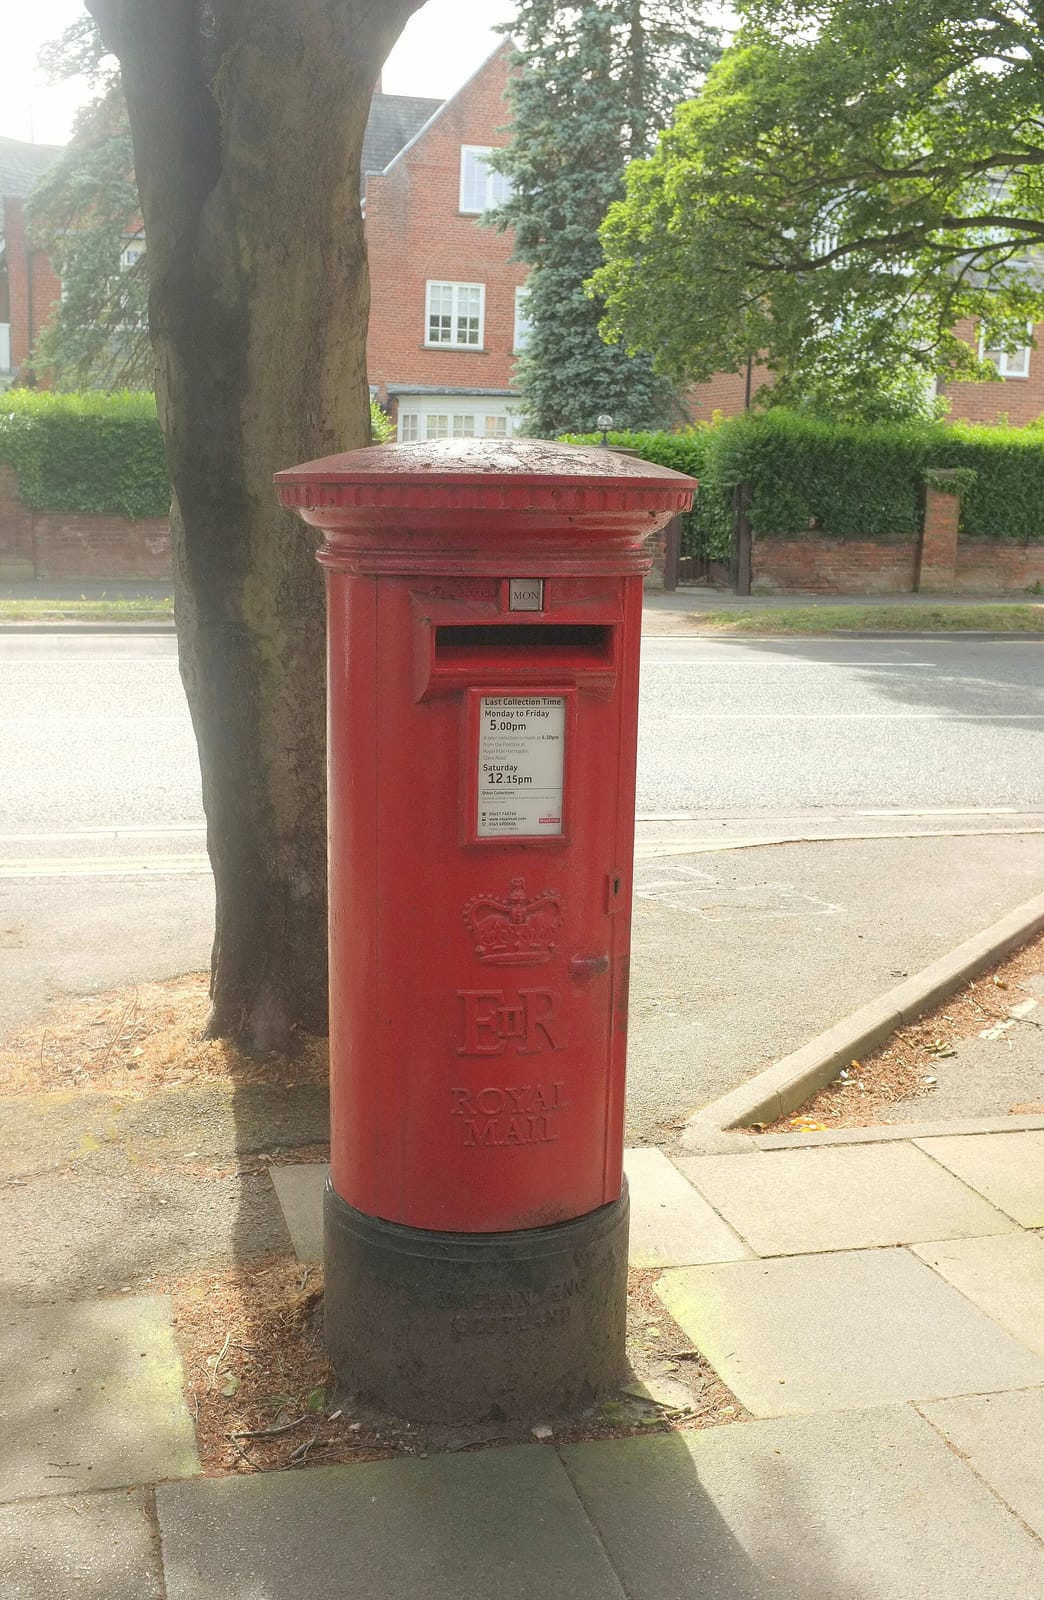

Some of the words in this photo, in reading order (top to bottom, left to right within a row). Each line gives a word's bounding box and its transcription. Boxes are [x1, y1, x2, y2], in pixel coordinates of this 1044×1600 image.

[513, 591, 539, 600] MON
[485, 698, 502, 706] Last
[503, 698, 541, 706] Collection
[542, 698, 561, 706] Time
[484, 710, 515, 718] Monday
[525, 710, 550, 718] Friday
[489, 719, 527, 732] 5.00pm
[483, 764, 518, 772] Saturday
[488, 772, 533, 784] 12.15pm
[450, 1082, 569, 1116] ROYAL
[463, 1114, 561, 1148] MAIL
